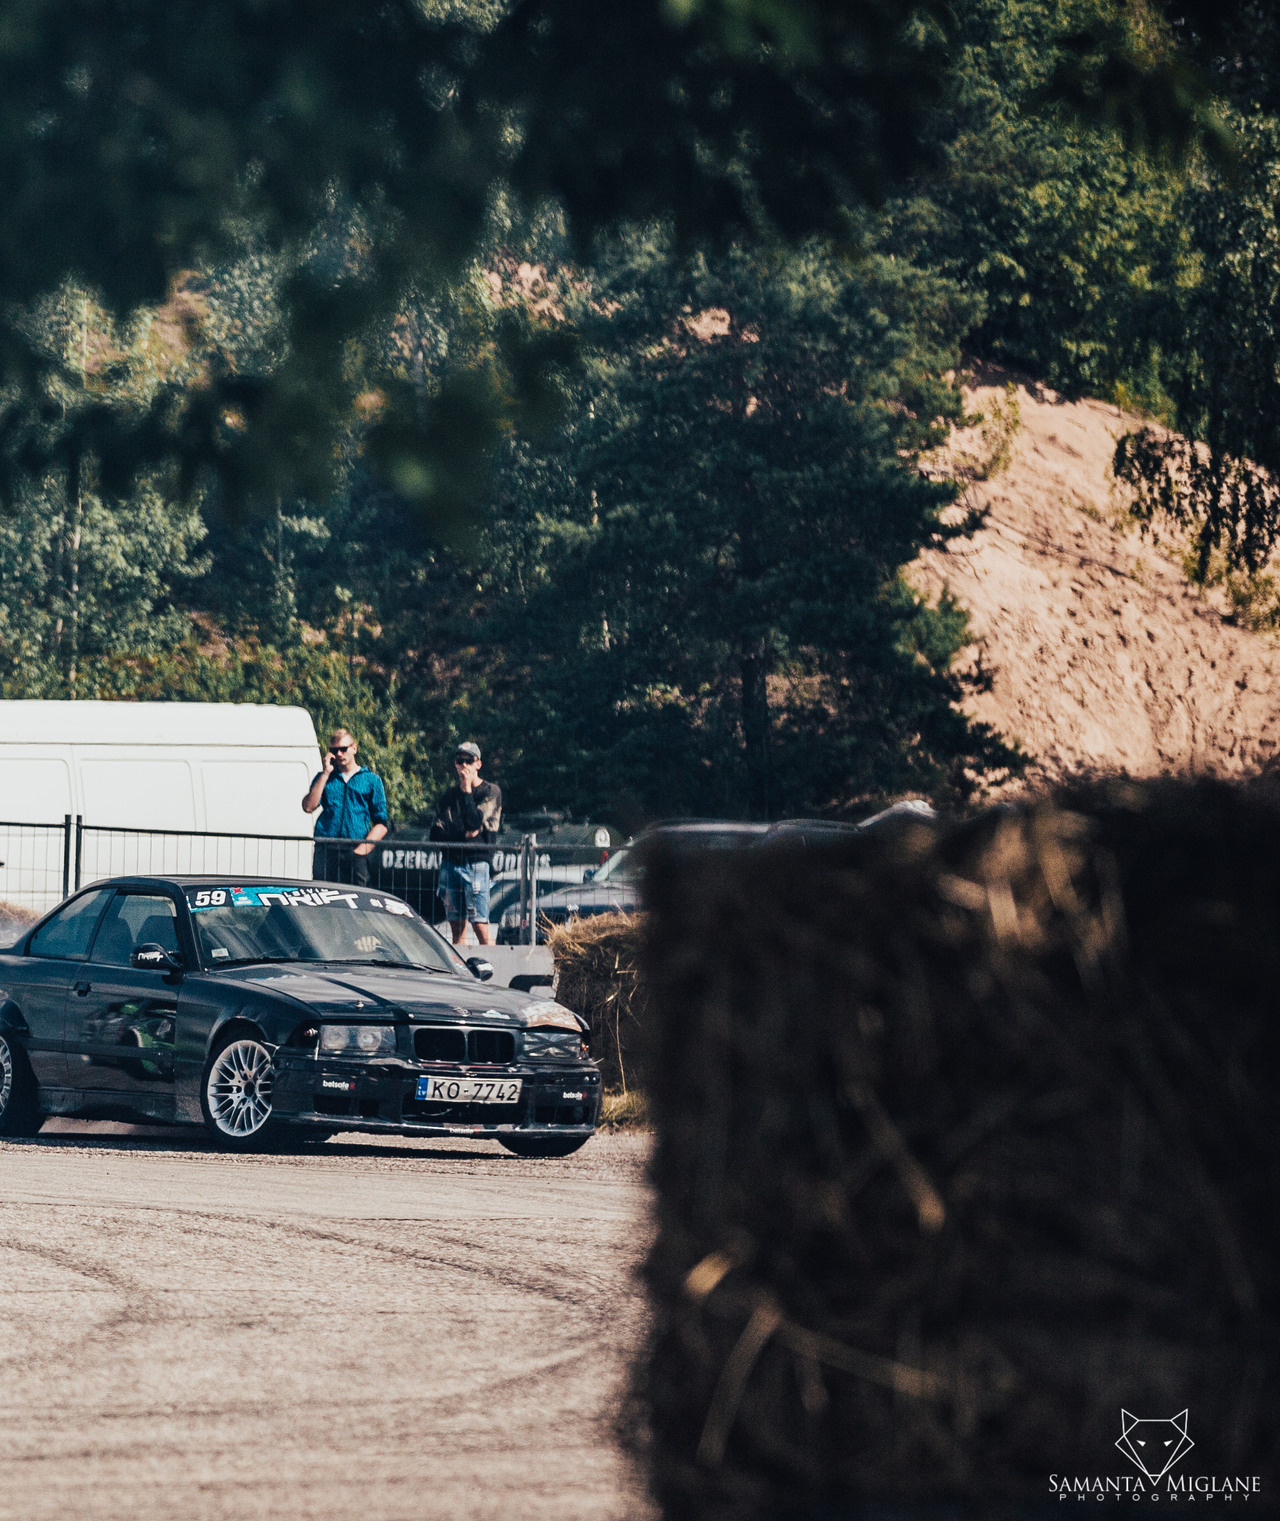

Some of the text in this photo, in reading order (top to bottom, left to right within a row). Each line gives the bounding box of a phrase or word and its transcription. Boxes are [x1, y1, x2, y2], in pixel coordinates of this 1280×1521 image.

[194, 890, 227, 907] 59
[322, 1080, 350, 1089] betsafe
[431, 1081, 518, 1102] KO-7742
